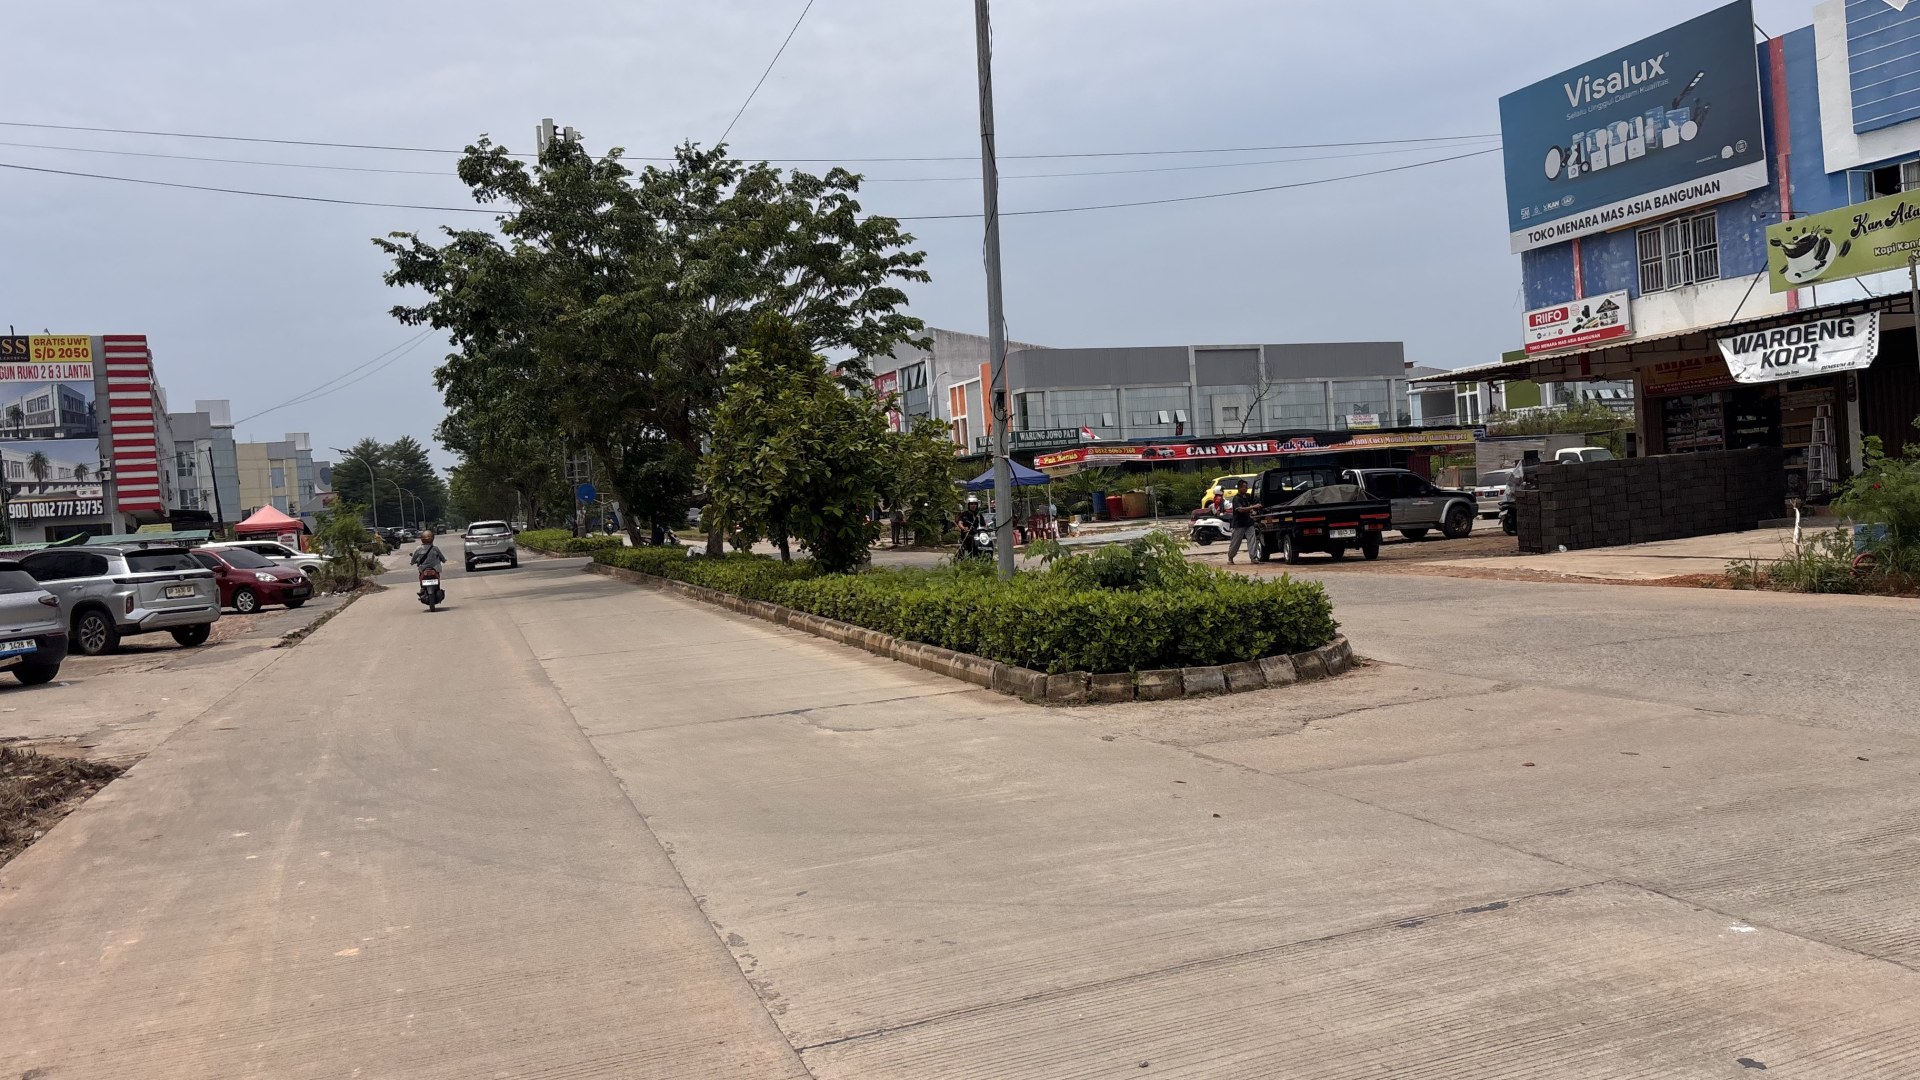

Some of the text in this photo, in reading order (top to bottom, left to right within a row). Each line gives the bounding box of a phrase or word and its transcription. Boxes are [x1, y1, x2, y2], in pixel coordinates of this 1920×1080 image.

[1564, 53, 1666, 108] Visalux
[1588, 99, 1614, 112] Unggul
[1615, 90, 1639, 103] Dalam
[1640, 78, 1669, 94] Kualitas
[1528, 179, 1721, 244] TOKO MENARA MAS ASIA BANGUNAN
[1850, 212, 1883, 238] Kan
[1874, 243, 1896, 256] Kopi
[1535, 310, 1562, 325] RIIFO
[33, 338, 88, 346] GRATIS UWT
[1577, 333, 1601, 342] BANGUNAN
[1732, 318, 1856, 355] WAROENG
[34, 347, 90, 361] S/D 2050
[1760, 344, 1820, 369] KOPI
[17, 365, 39, 379] RUKO
[41, 365, 46, 379] 2
[48, 365, 54, 378] &
[56, 364, 61, 378] 3
[63, 364, 91, 379] LANTAI
[1020, 431, 1045, 440] WARUNG
[1046, 430, 1063, 439] JOWO
[1063, 429, 1077, 439] PATI
[1186, 446, 1217, 455] CAR
[1222, 443, 1268, 454] WASH
[1274, 440, 1297, 450] Pak
[8, 500, 103, 519] 900 0812 777 33735
